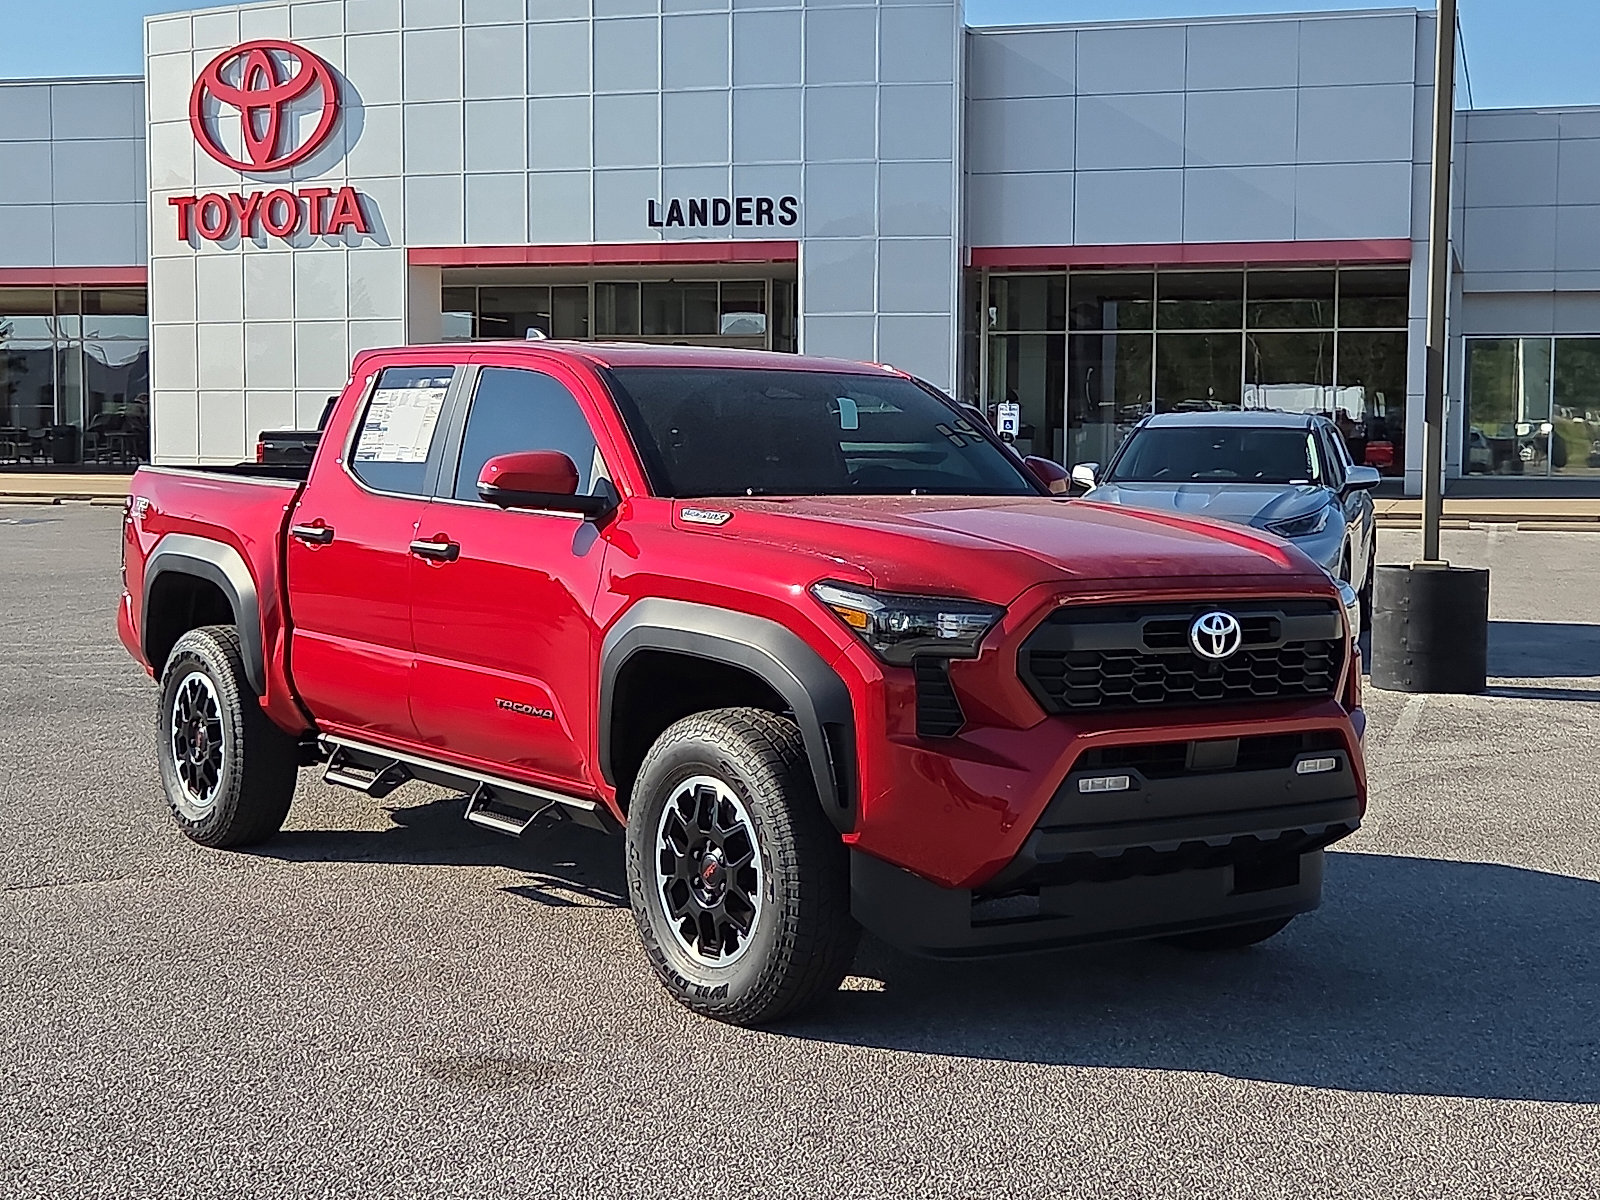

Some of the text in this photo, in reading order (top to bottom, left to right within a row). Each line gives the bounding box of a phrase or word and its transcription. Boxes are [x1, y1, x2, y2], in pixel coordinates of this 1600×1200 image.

[168, 187, 369, 241] TOYOTA
[647, 196, 798, 227] LANDERS
[494, 697, 555, 720] TACOMA
